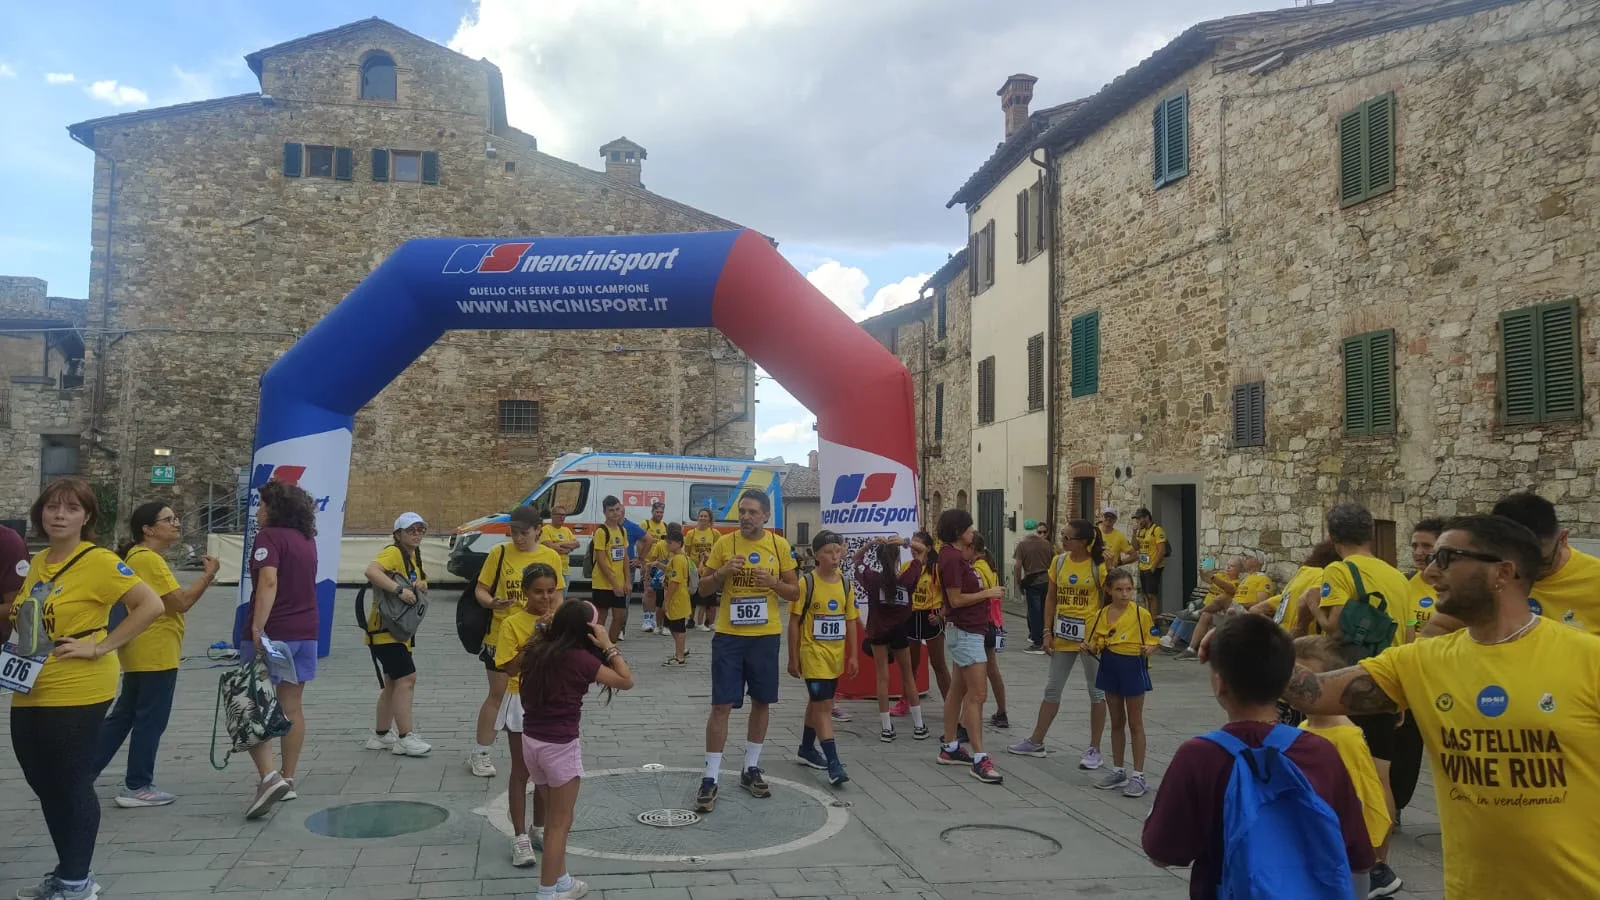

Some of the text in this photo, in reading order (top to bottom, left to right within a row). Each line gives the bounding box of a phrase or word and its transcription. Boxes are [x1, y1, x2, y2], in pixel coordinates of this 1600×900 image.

[522, 248, 680, 275] nencinisport
[469, 283, 650, 296] QUELLO CHE SERVE AD UN CAMPIONE
[456, 297, 669, 315] WWW.NENCINISPORT.IT
[1073, 596, 1089, 606] RUN
[737, 605, 760, 618] 562
[821, 622, 839, 634] 618
[1060, 622, 1078, 636] 620
[2, 657, 31, 682] 676
[1440, 727, 1561, 753] CASTELLINA
[1440, 753, 1567, 788] WINE RUN
[1494, 792, 1568, 807] vendemmia!
